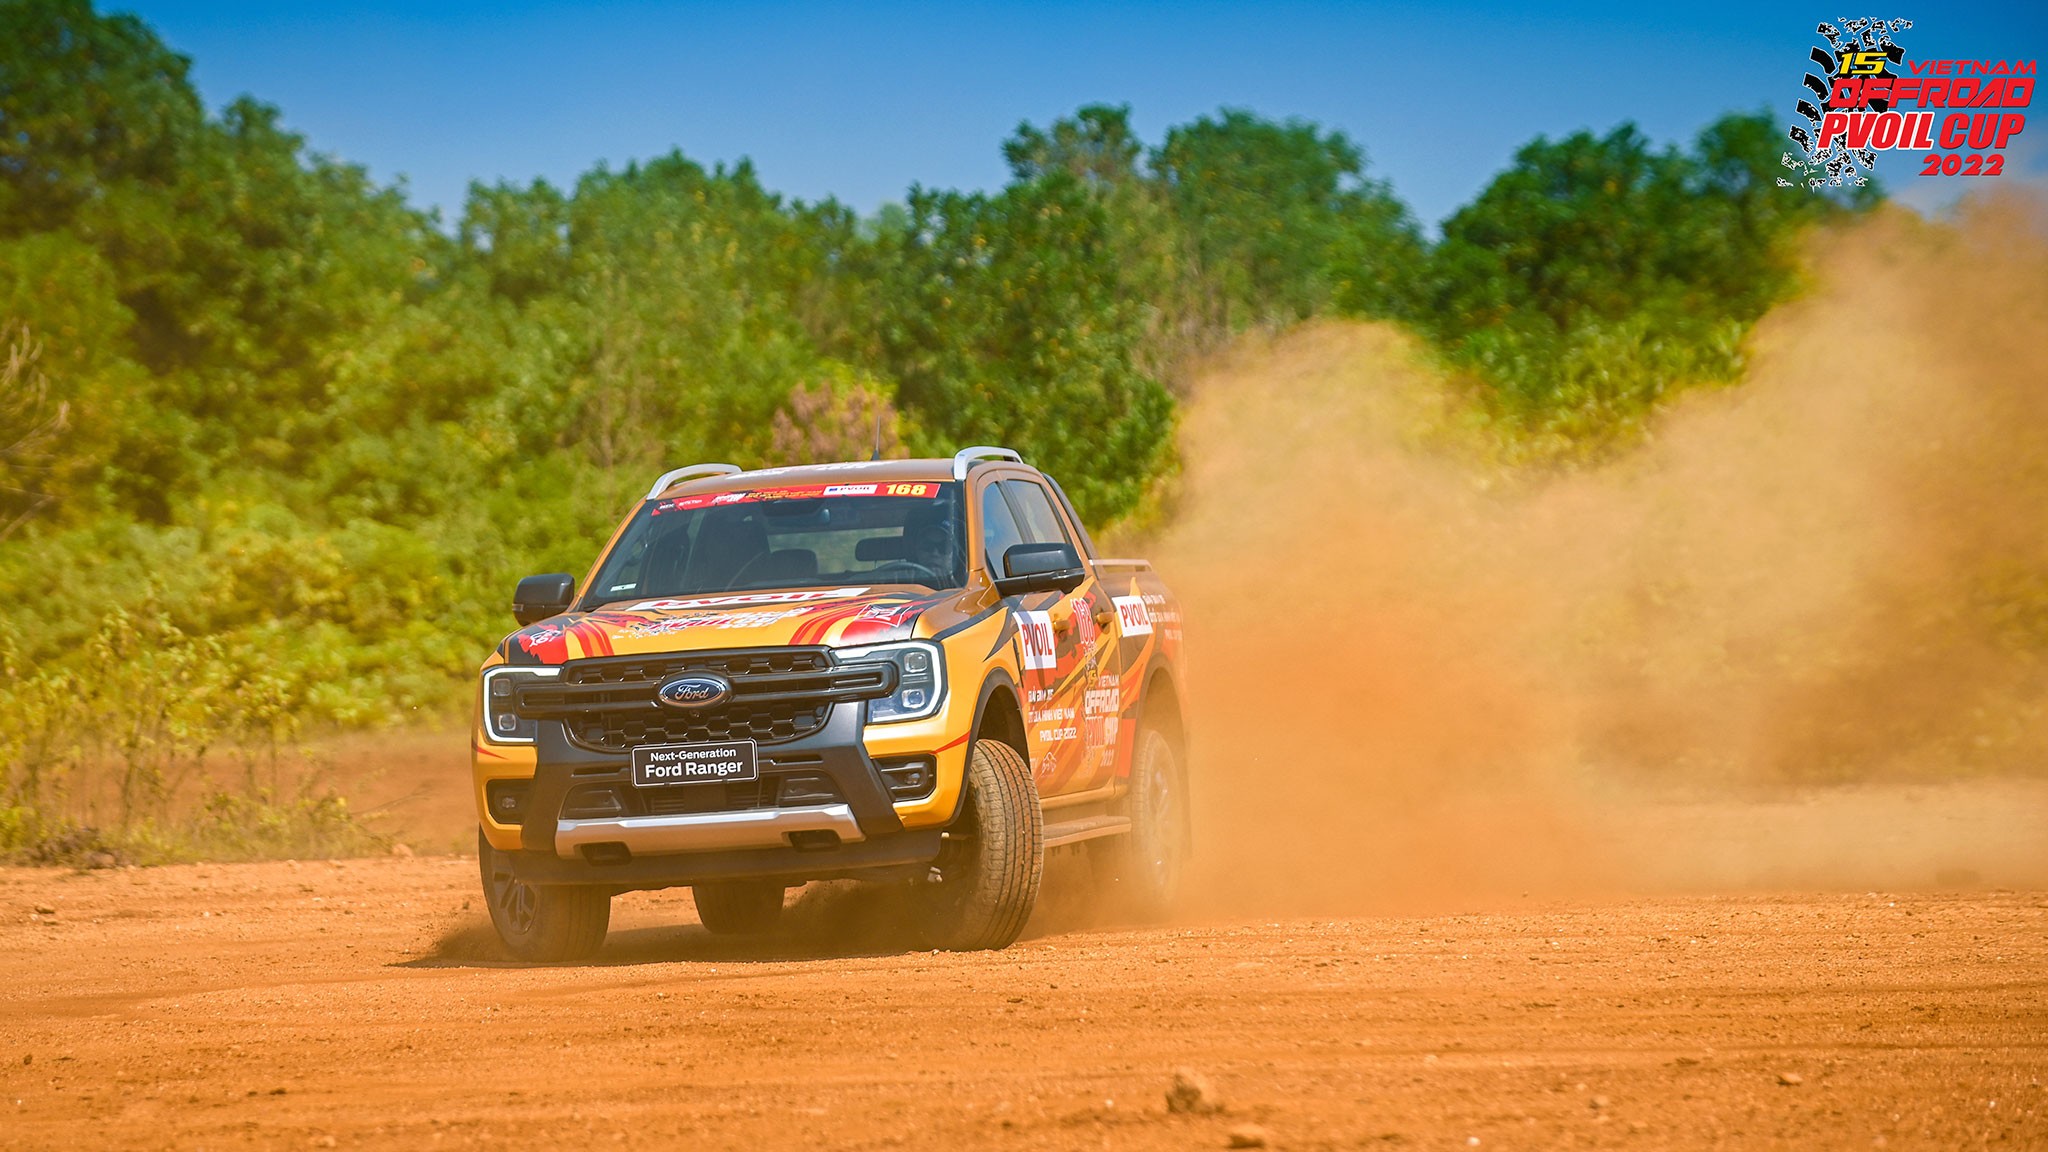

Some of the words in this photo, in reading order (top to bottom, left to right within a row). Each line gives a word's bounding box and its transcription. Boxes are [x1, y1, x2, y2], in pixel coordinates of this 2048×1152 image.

[886, 484, 927, 496] 168
[1120, 603, 1148, 627] PVOIL
[1021, 623, 1053, 656] PVOIL
[674, 684, 709, 700] Ford
[651, 748, 736, 762] Next-Generation
[645, 763, 682, 778] Ford
[686, 761, 743, 776] Ranger
